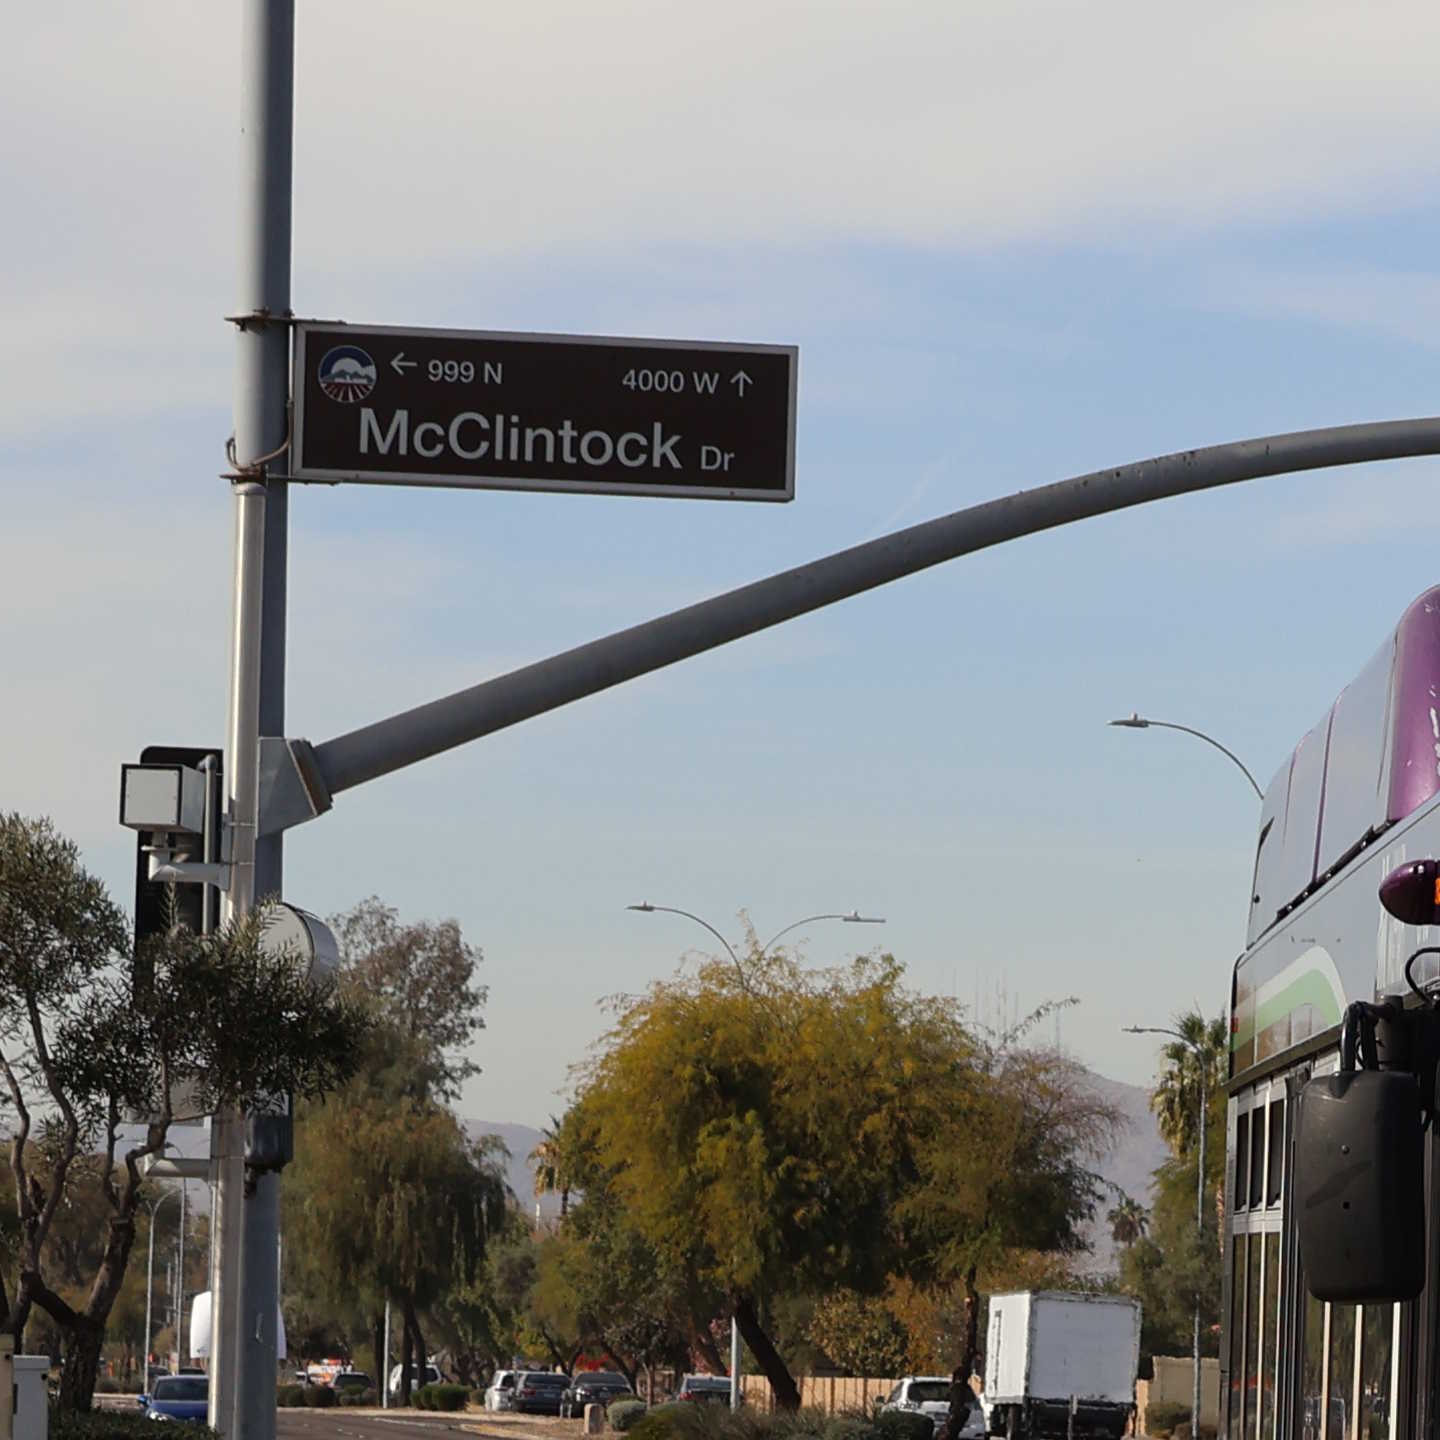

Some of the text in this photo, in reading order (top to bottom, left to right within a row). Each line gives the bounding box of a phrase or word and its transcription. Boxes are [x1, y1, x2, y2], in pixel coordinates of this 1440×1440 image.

[427, 360, 503, 385] 999 N
[622, 369, 720, 395] 4000 W
[358, 407, 735, 471] McClintock Dr
